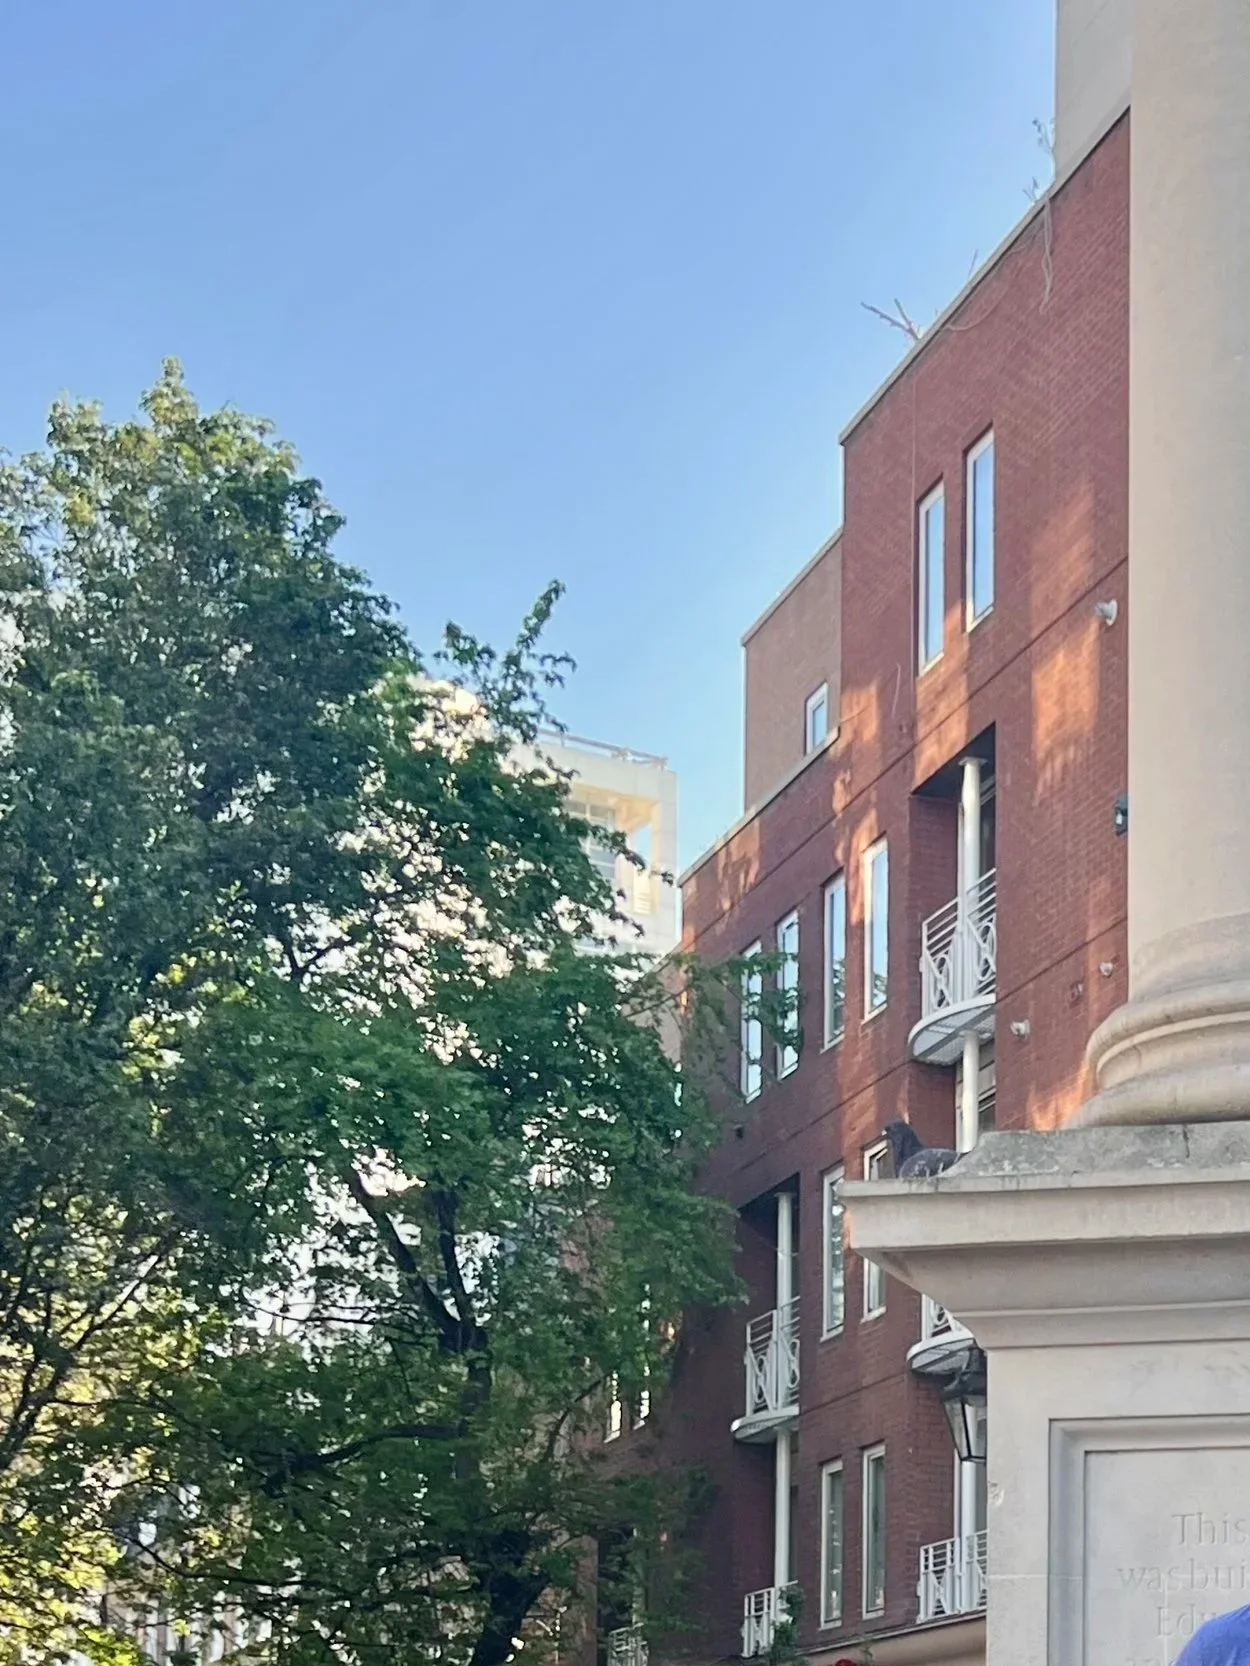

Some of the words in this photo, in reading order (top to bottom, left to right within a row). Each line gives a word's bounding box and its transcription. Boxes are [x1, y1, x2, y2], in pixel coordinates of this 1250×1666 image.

[1171, 1511, 1247, 1545] This
[1116, 1566, 1178, 1592] was
[1156, 1603, 1217, 1636] Ed
